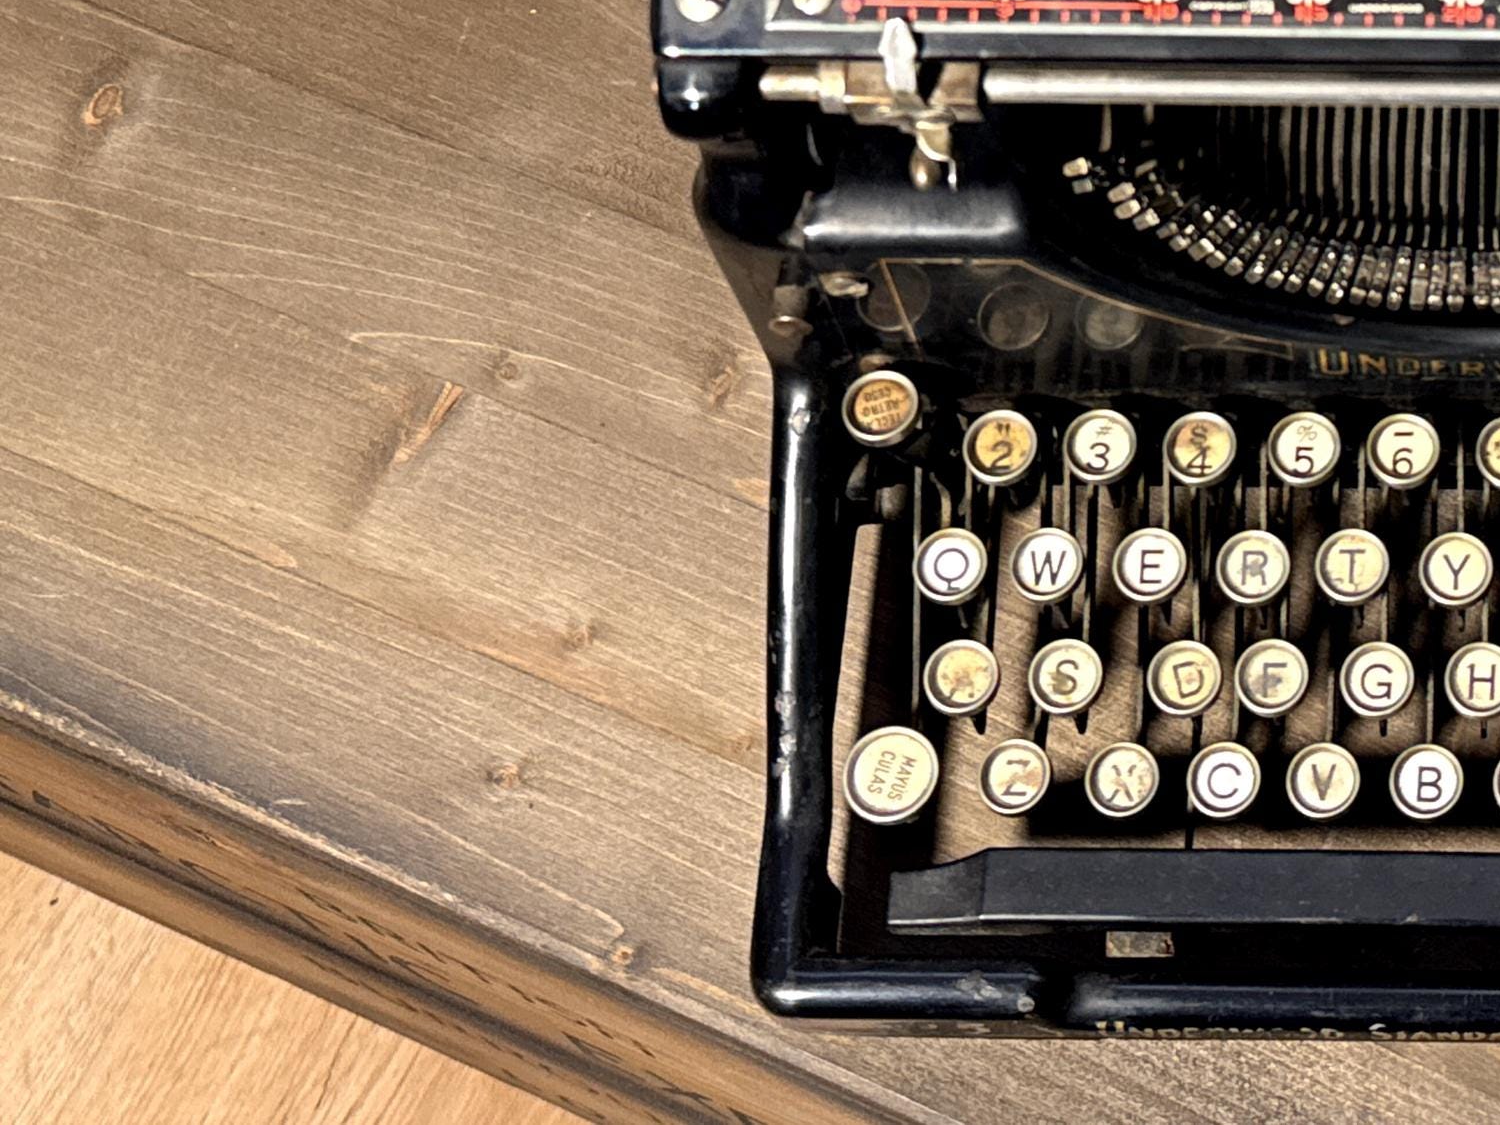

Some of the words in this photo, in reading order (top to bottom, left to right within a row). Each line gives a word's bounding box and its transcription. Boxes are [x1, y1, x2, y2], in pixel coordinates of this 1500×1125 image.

[991, 440, 1012, 473] 2
[1086, 442, 1111, 471] 3
[1186, 447, 1213, 475] 4
[1290, 446, 1315, 476] 5
[1392, 448, 1413, 476] 6
[933, 547, 970, 592] Q
[1030, 550, 1067, 587] W
[1139, 549, 1165, 585] E
[1240, 550, 1268, 586] R
[1338, 549, 1366, 584] T
[1442, 553, 1471, 591] Y
[1052, 658, 1080, 696] S
[1172, 661, 1205, 700] D
[1261, 662, 1288, 699] F
[1360, 662, 1394, 701] G
[1466, 663, 1497, 701] H
[866, 749, 897, 795] CULAS
[1206, 762, 1242, 800] C
[1311, 762, 1337, 801] V
[1416, 765, 1443, 803] B
